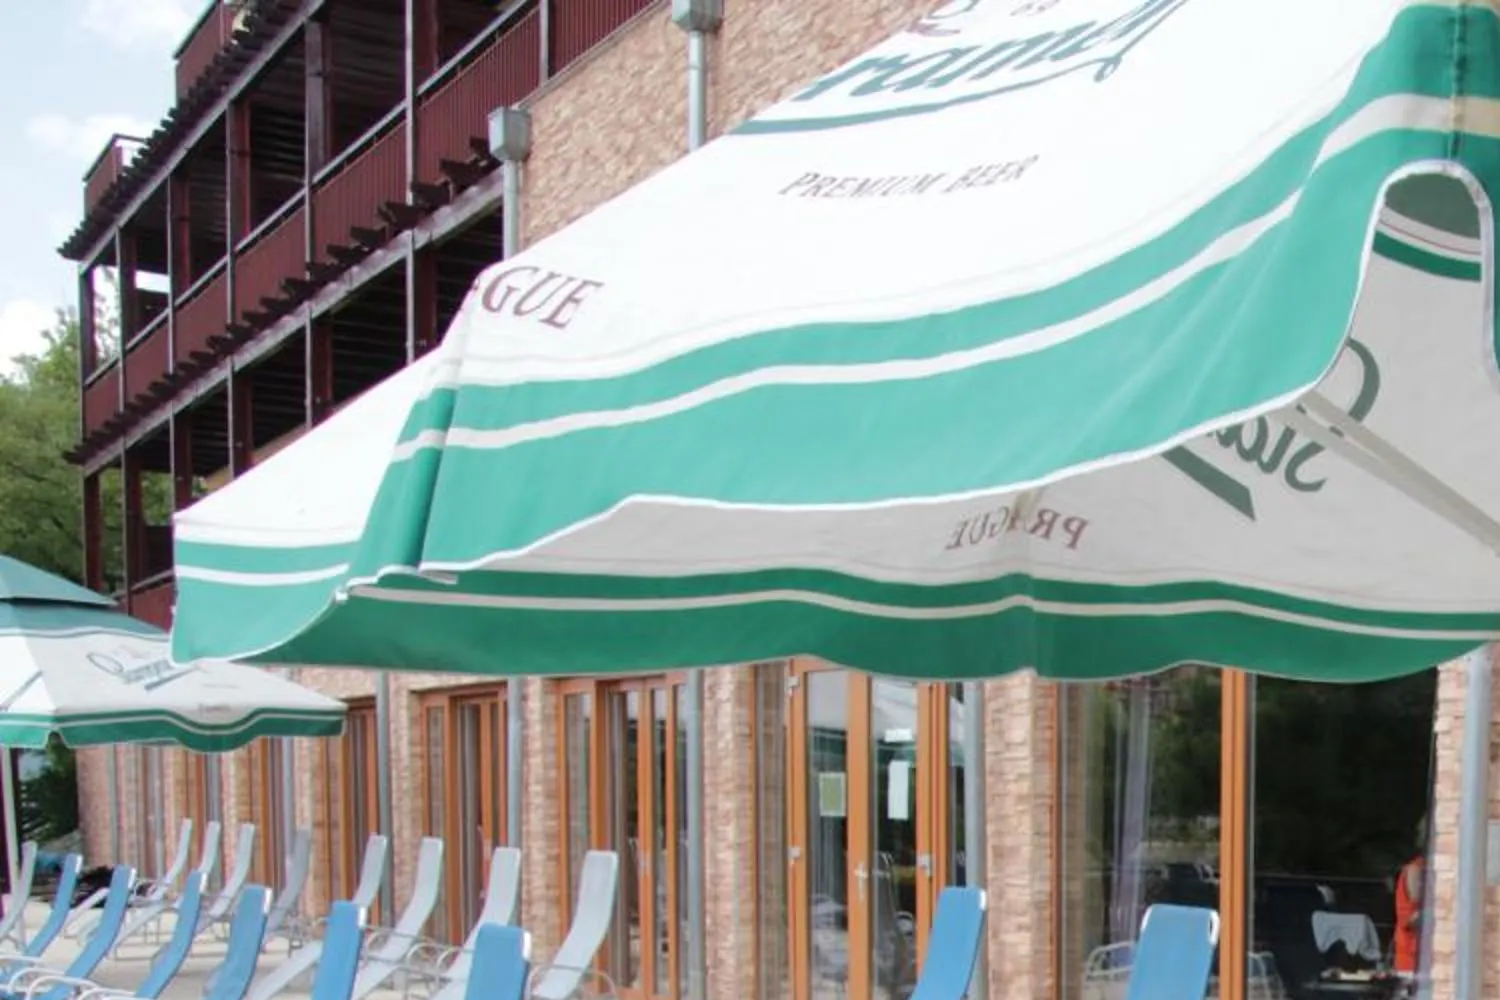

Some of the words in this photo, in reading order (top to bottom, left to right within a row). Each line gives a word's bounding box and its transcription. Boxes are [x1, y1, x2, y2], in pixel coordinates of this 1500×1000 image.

[778, 171, 948, 199] PREMIUM
[944, 153, 1040, 194] BEER
[474, 265, 605, 329] GUE
